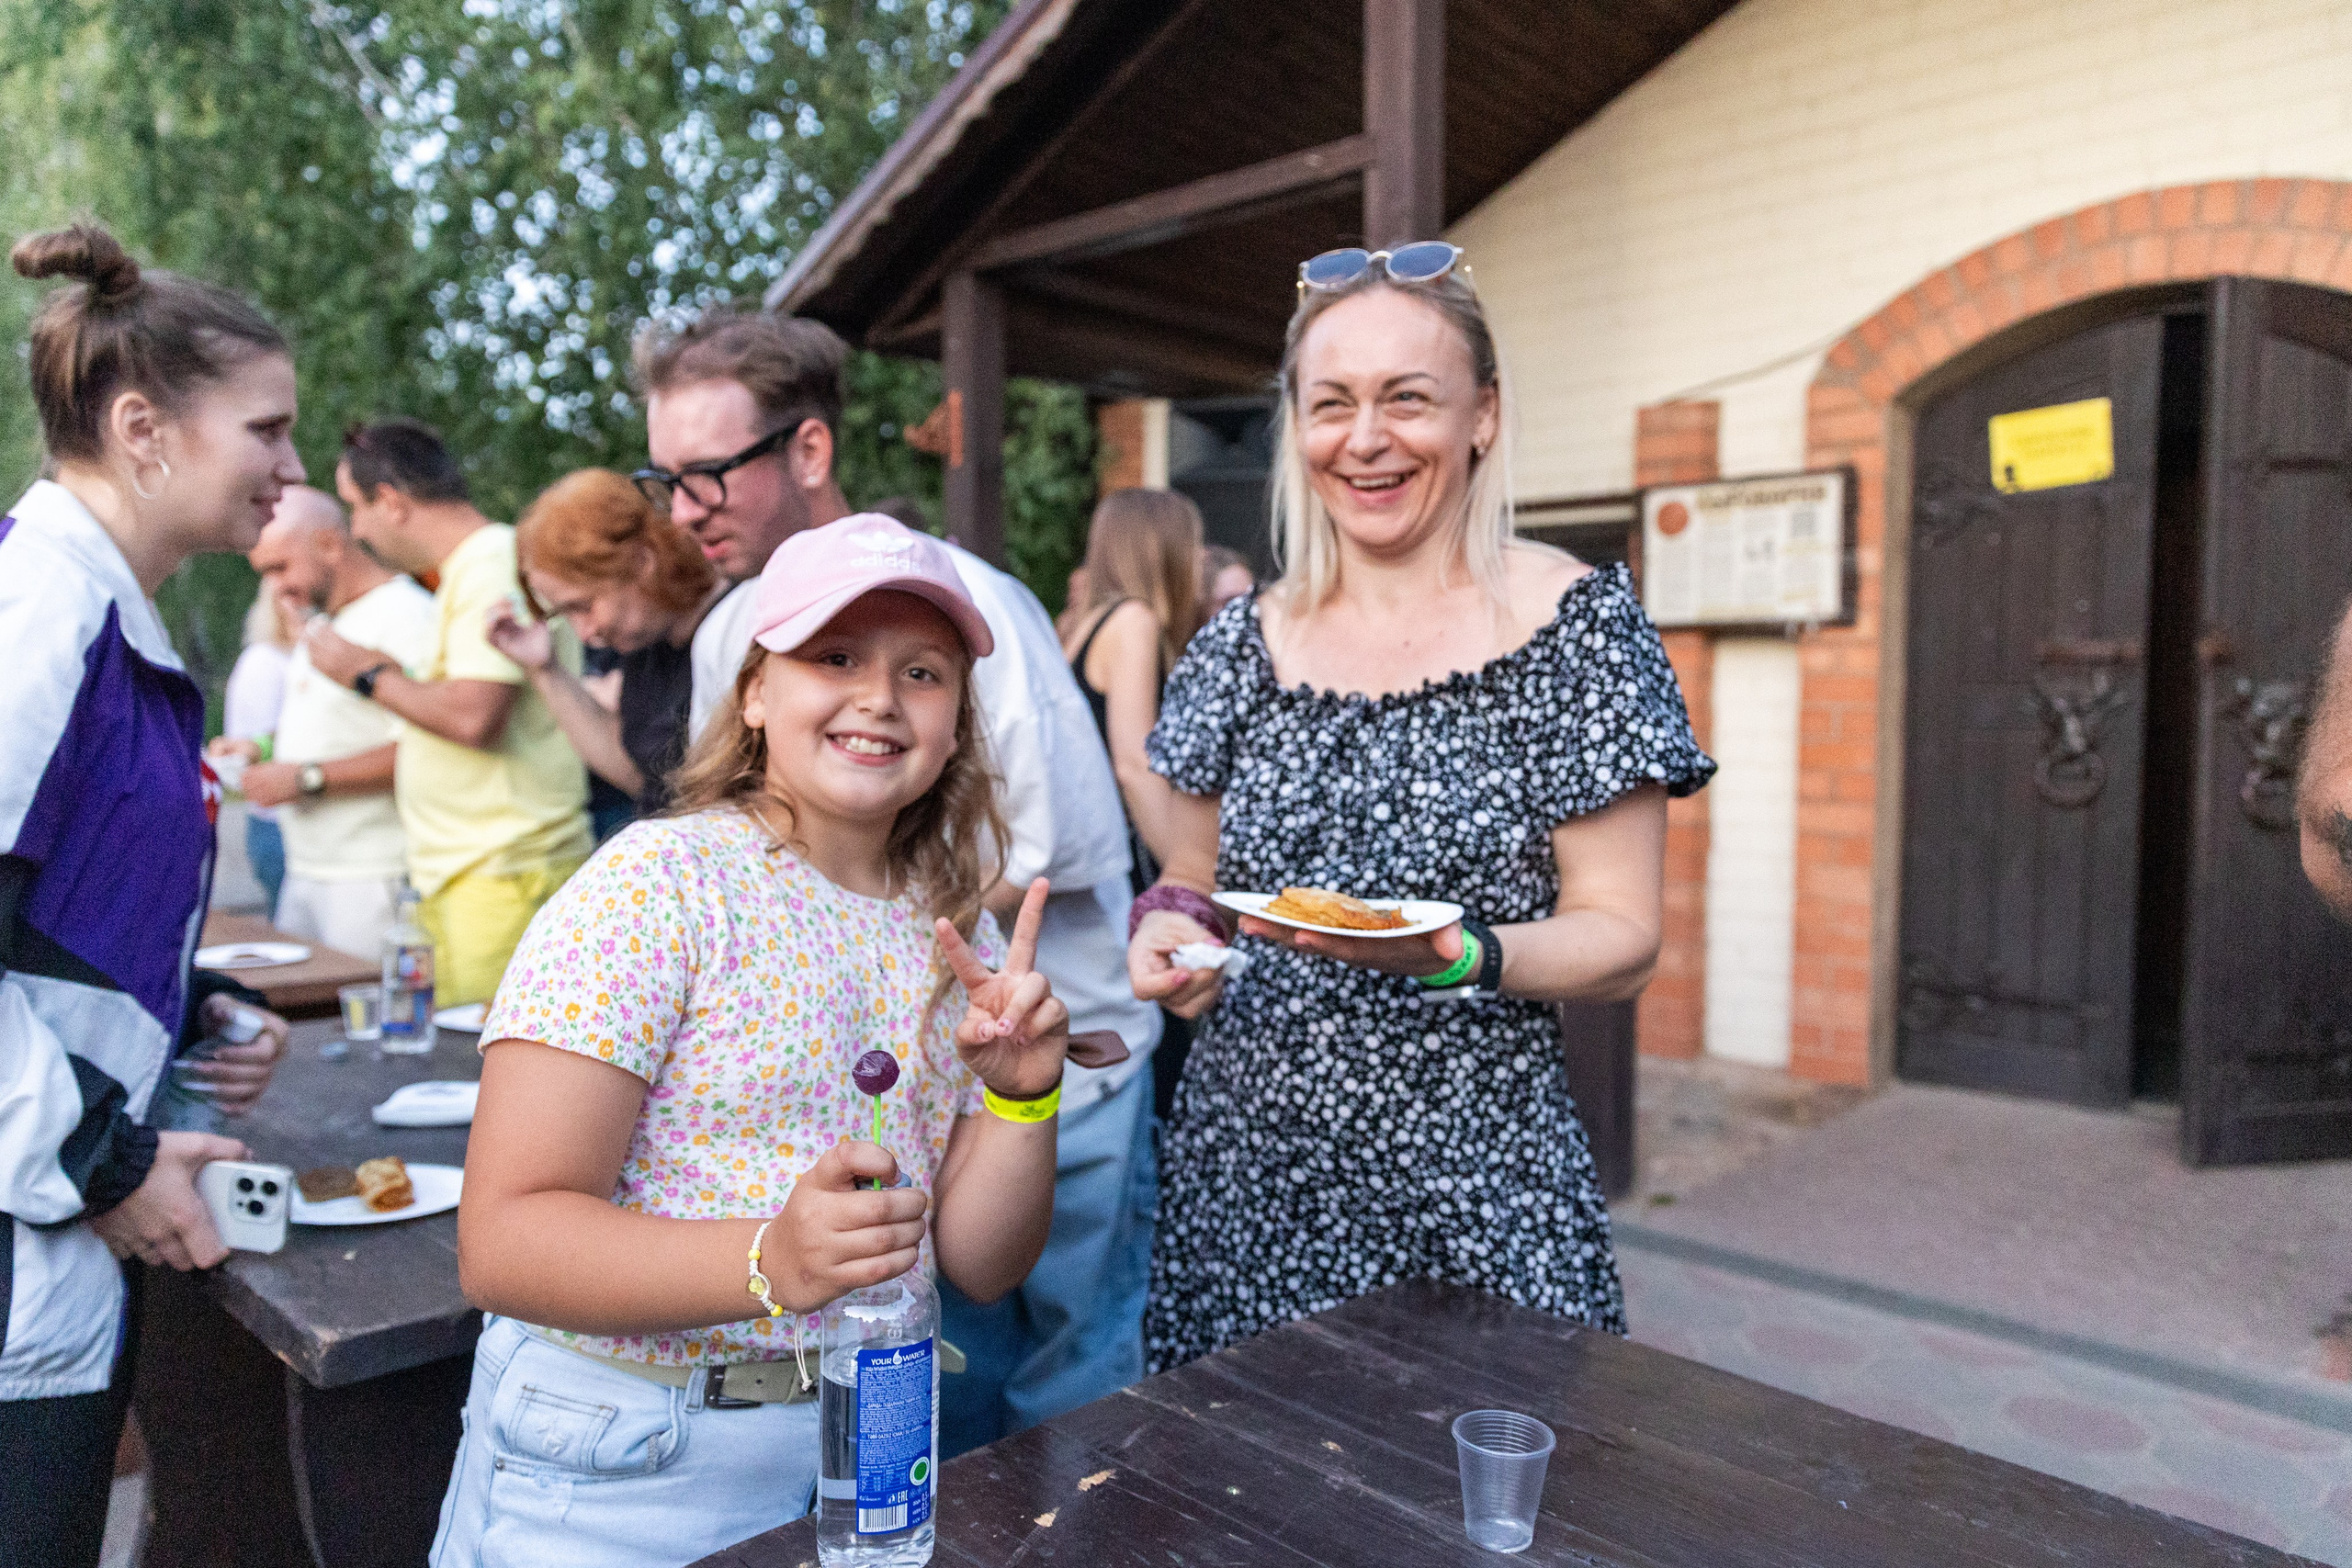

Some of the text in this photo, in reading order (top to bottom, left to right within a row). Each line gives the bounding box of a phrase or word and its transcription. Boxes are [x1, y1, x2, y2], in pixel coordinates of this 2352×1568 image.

[850, 553, 922, 573] adidas
[871, 1349, 925, 1366] YOUR WATER
